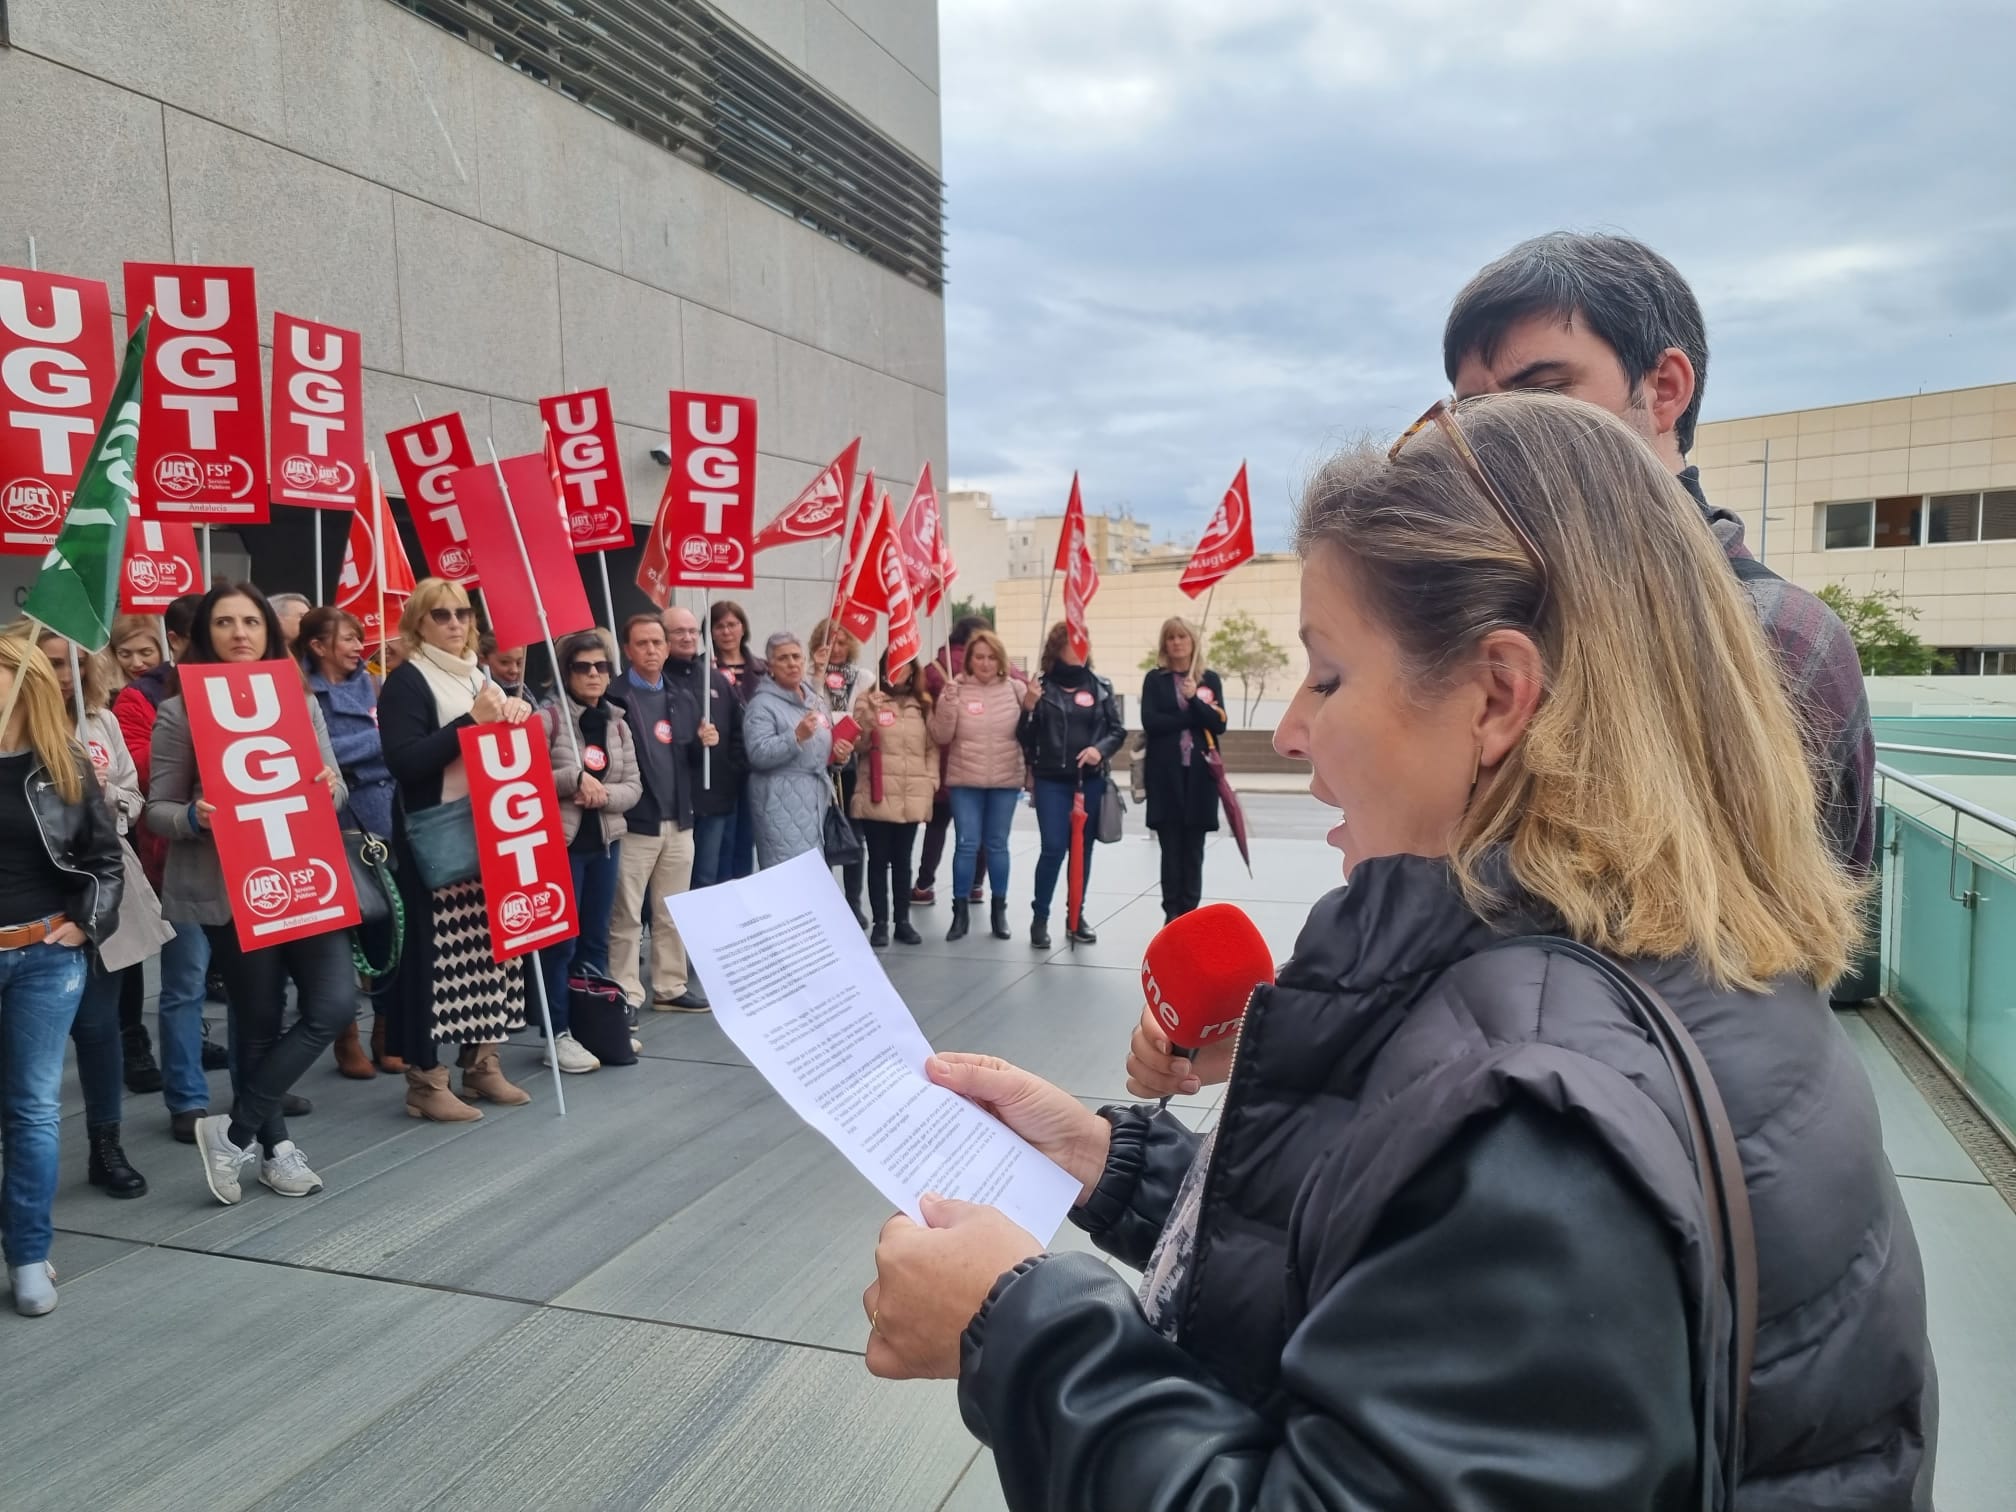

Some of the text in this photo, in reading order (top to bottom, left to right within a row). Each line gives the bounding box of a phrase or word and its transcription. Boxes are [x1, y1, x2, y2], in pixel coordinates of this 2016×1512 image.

[0, 278, 95, 475] UGT
[154, 276, 239, 450] UGT
[289, 325, 345, 457] UGT
[161, 461, 232, 479] UGT FSP
[287, 460, 313, 475] UGT
[404, 425, 467, 542] UGT
[556, 397, 608, 506] UGT
[687, 402, 740, 534] UGT
[9, 486, 50, 507] UGT
[132, 561, 176, 576] UGT FSP
[683, 541, 708, 556] UGT
[204, 673, 308, 861] UGT
[477, 727, 549, 887] UGT
[249, 874, 282, 897] UGT
[290, 868, 315, 886] FSP
[504, 898, 527, 917] UGT
[533, 891, 550, 906] FSP
[1142, 960, 1179, 1030] rne
[1200, 1017, 1244, 1038] rn
